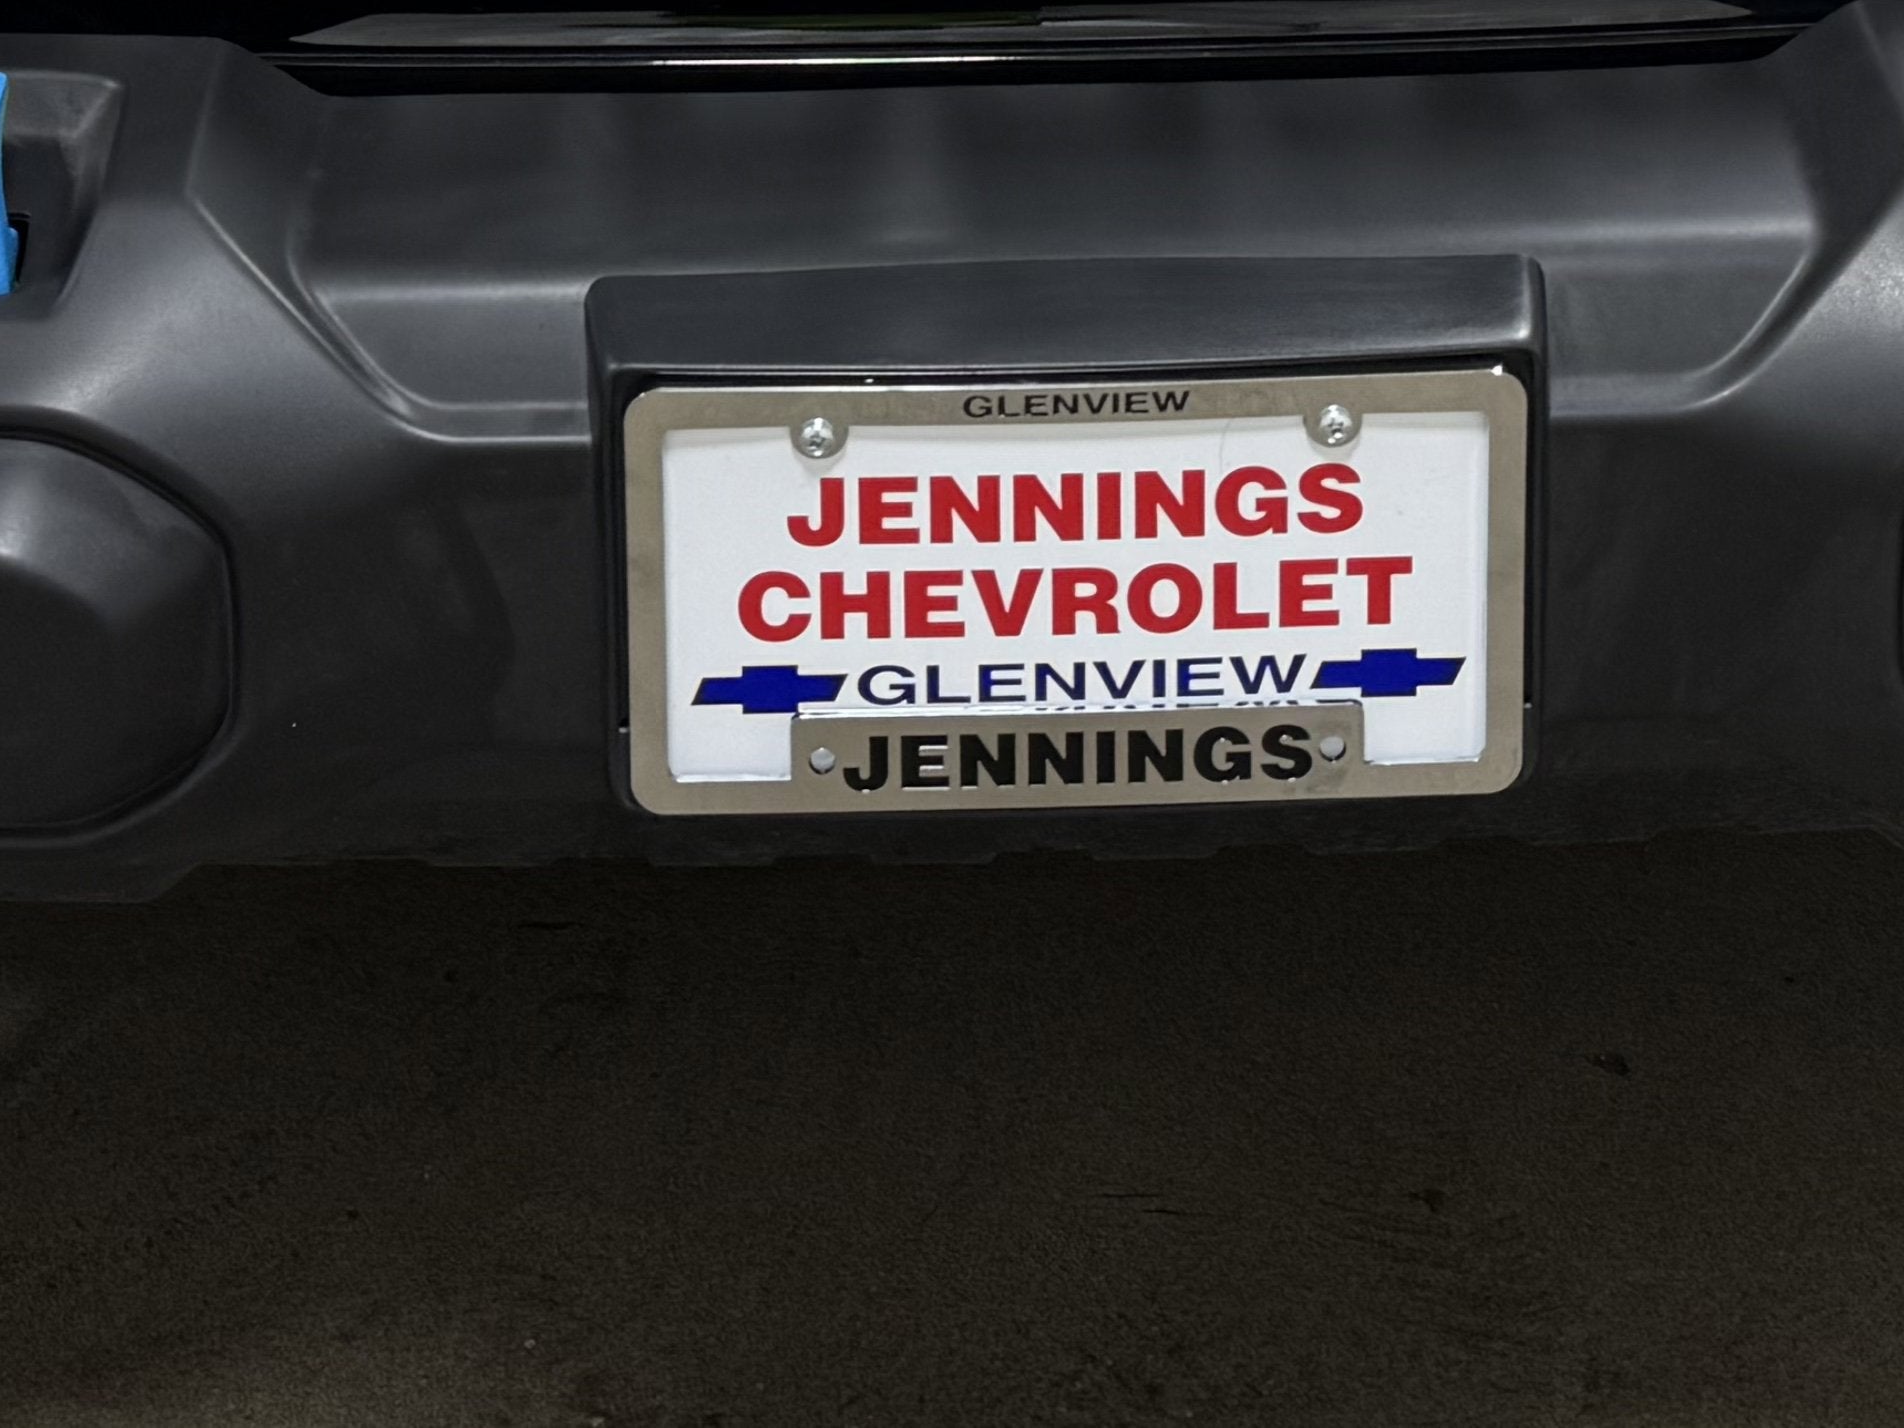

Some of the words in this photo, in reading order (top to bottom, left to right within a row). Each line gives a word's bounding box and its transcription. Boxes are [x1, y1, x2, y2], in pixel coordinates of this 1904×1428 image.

[963, 390, 1191, 419] GLENVIEW
[787, 463, 1363, 547] JENNINGS
[738, 556, 1414, 643] CHEVROLET
[857, 653, 1307, 705] GLENVIEW
[843, 723, 1313, 792] JENNINGS
